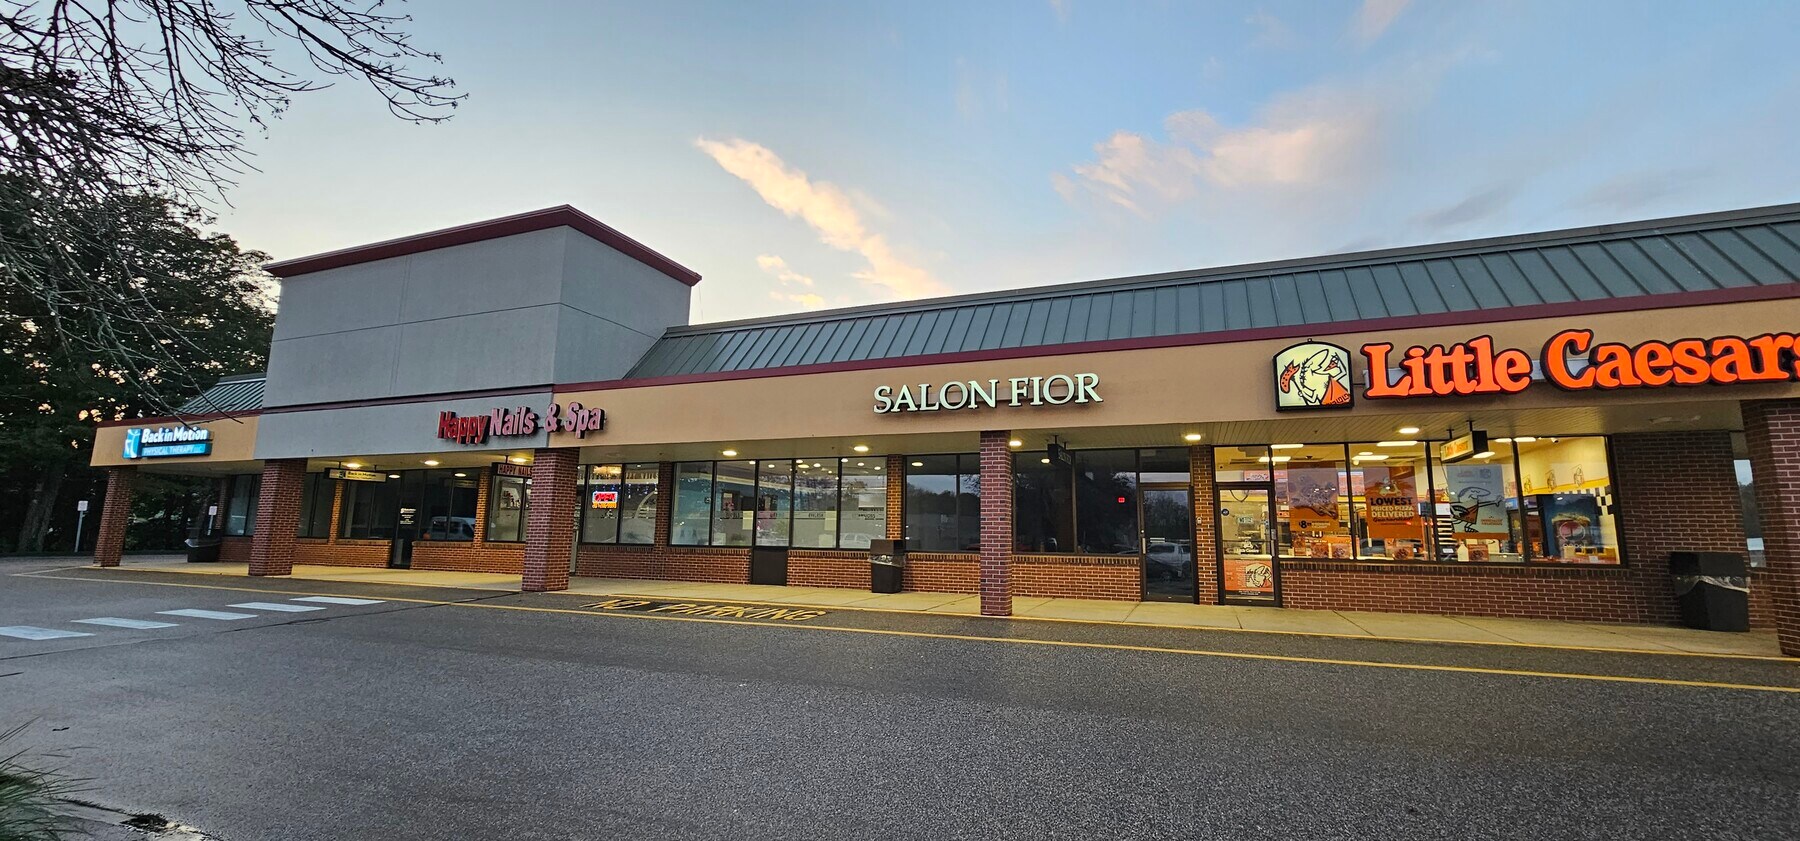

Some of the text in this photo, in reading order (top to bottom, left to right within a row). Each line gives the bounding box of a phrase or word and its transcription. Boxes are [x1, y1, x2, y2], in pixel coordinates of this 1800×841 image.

[1363, 331, 1800, 397] Little Caesar
[872, 373, 1104, 414] SALON FIOR
[437, 401, 602, 444] Happy Nails & Spa
[141, 426, 208, 444] Back in Motion
[143, 446, 168, 456] PHYSICAL
[169, 445, 194, 454] THERAPY
[498, 464, 533, 477] HAPPY NAILS
[594, 493, 616, 502] OPEN
[1370, 497, 1412, 506] LOWEST
[579, 600, 827, 621] NO PARKING
